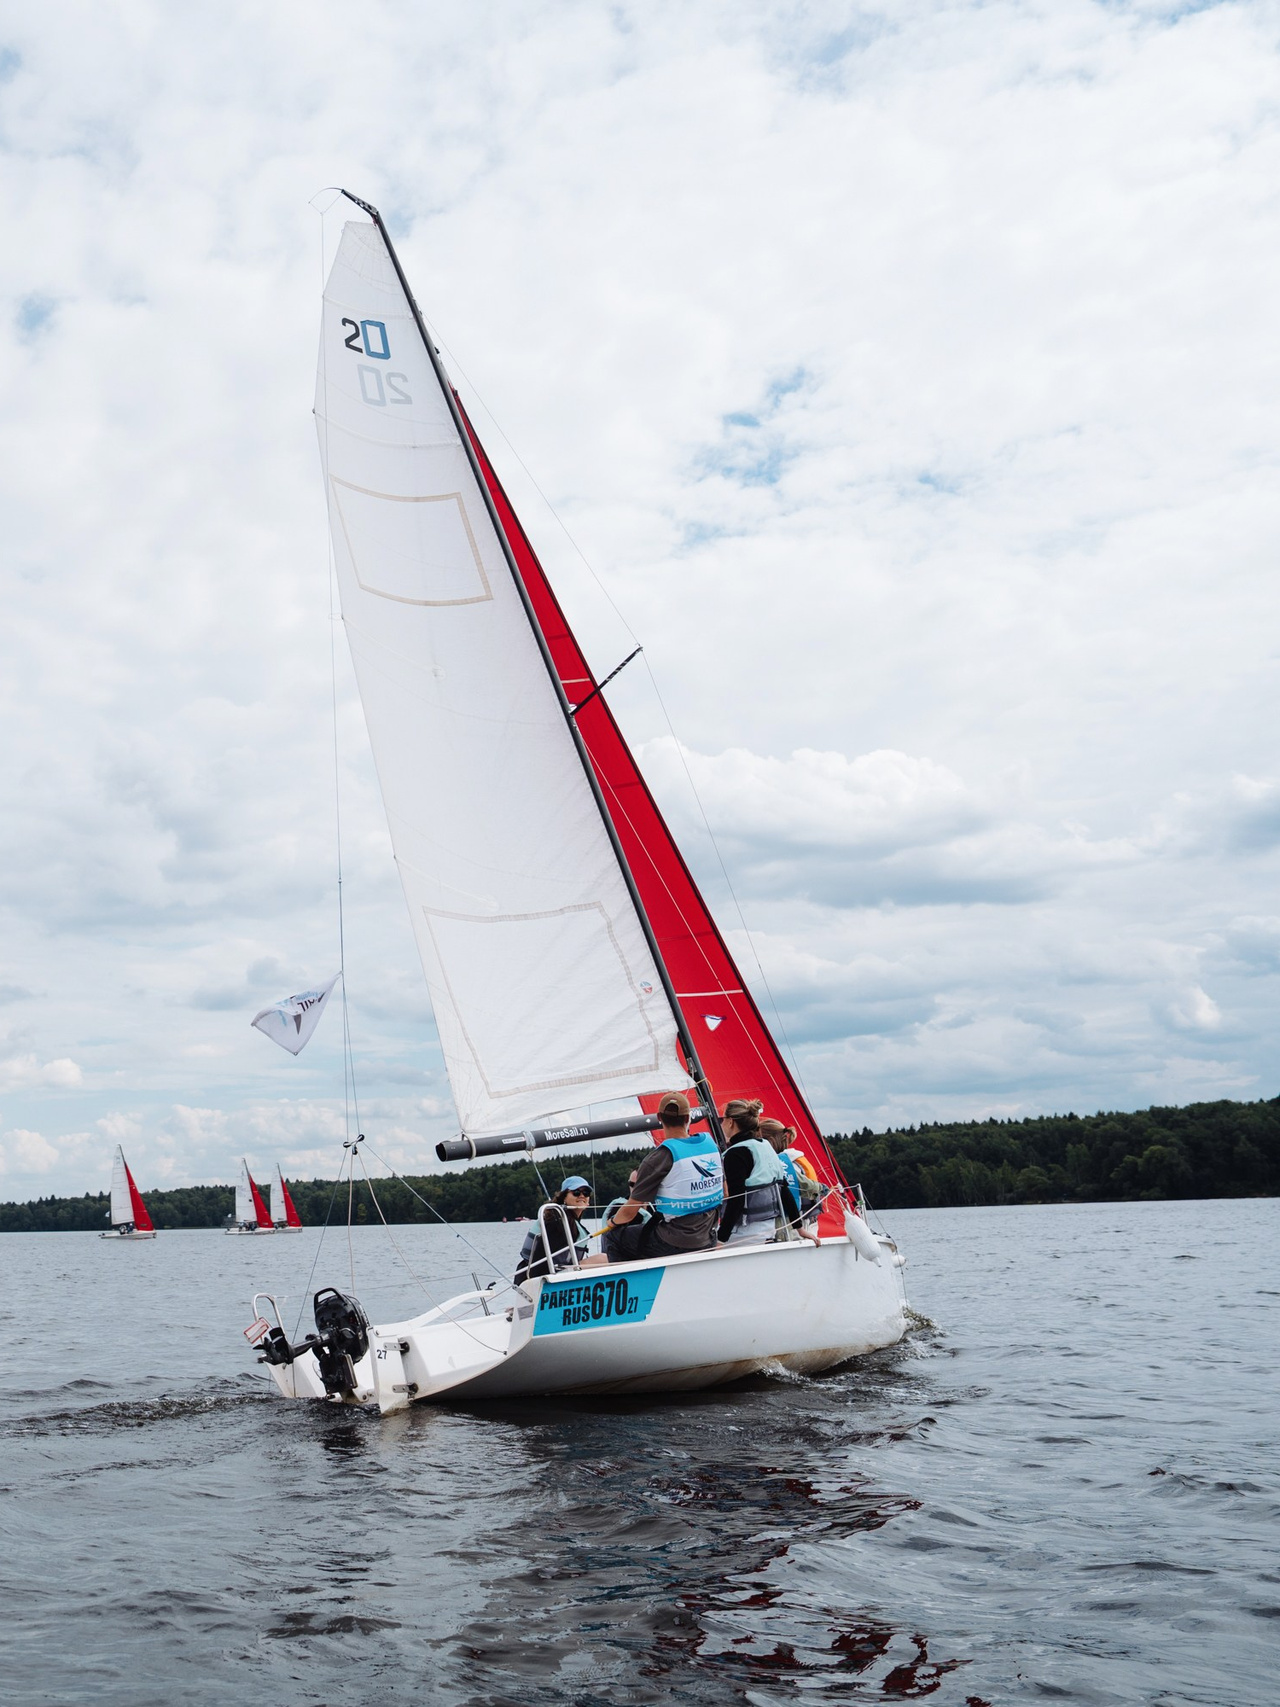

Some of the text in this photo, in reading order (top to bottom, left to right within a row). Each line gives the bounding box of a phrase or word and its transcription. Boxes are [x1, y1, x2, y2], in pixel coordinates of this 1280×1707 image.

[341, 317, 391, 360] 20
[544, 1126, 589, 1141] MoreSail.ru
[591, 1278, 639, 1320] 670 27
[562, 1305, 590, 1326] RUS
[376, 1349, 387, 1360] 27
